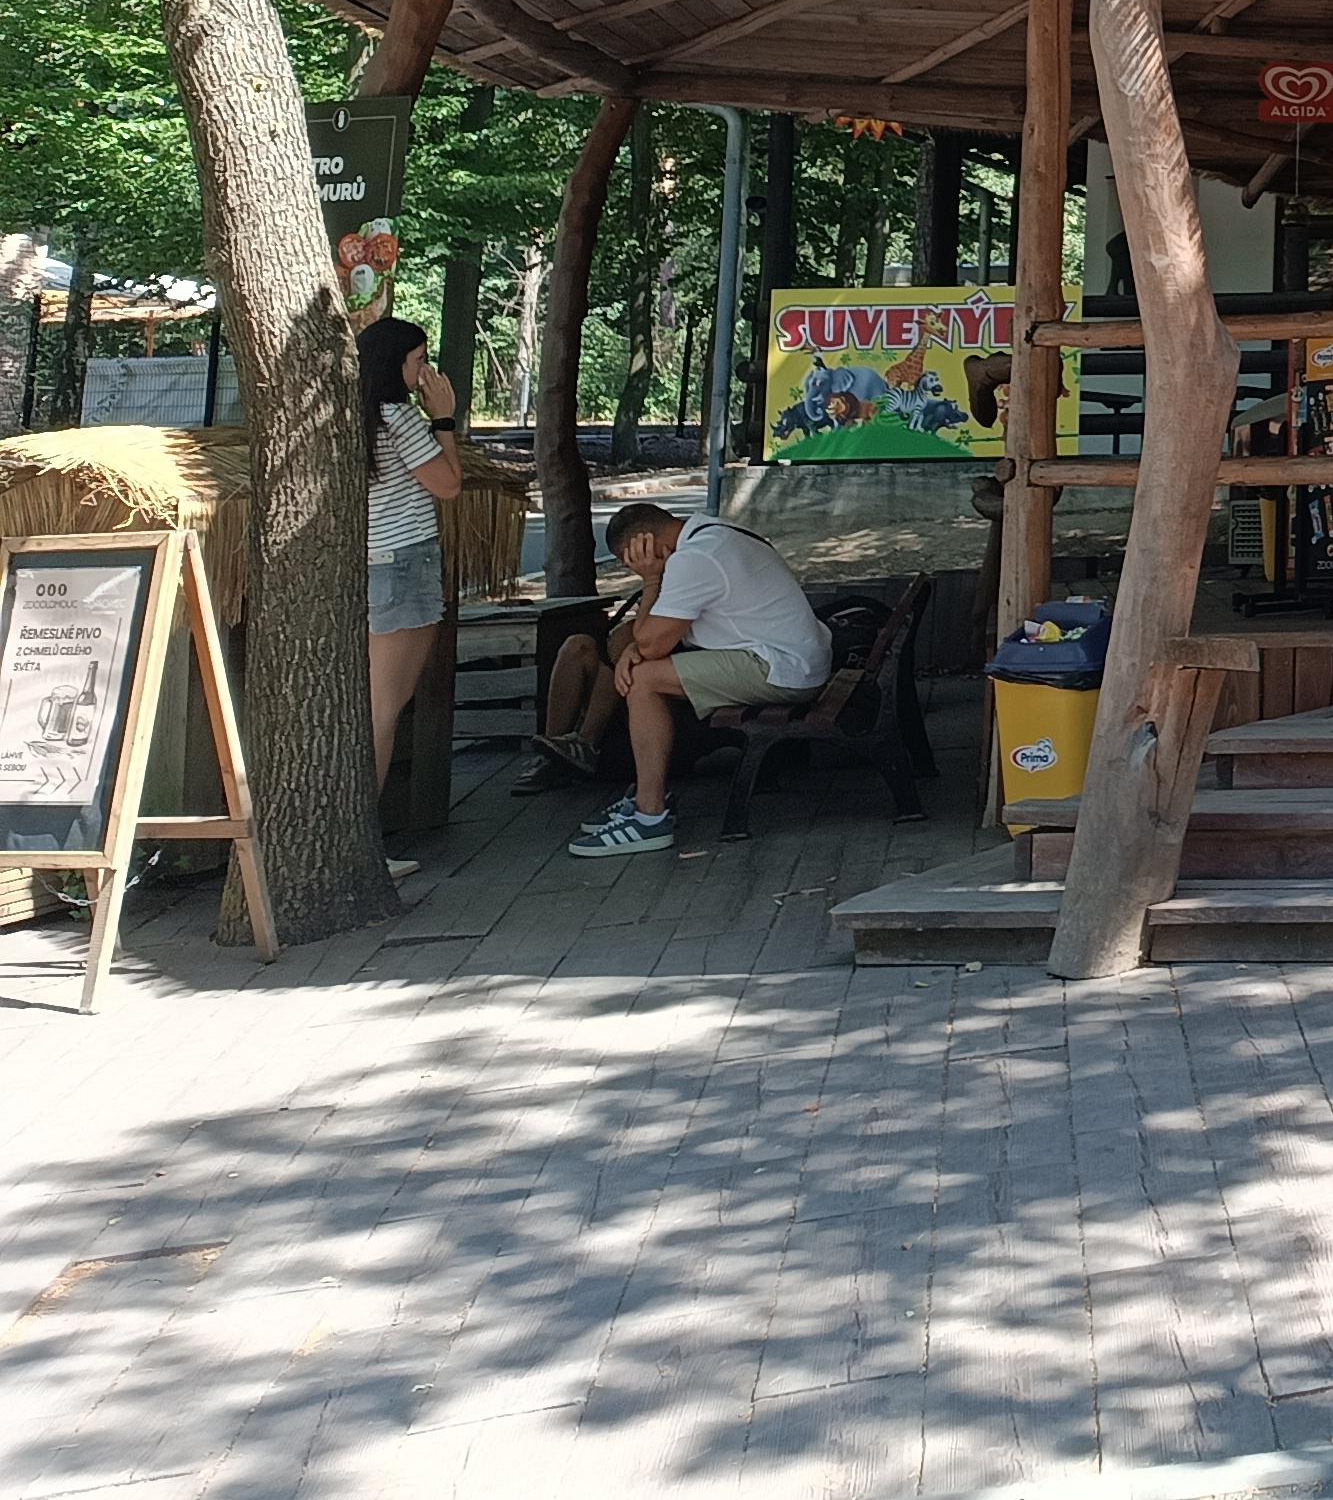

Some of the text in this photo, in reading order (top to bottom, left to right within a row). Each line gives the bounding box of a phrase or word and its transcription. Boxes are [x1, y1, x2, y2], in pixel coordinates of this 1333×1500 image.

[1270, 106, 1326, 117] ALGIDA
[313, 156, 344, 175] TRO
[318, 175, 365, 201] MURŮ
[23, 600, 78, 610] ZOOOLOMOUC
[20, 625, 102, 640] ŘEMESLNÉ PIVO
[16, 645, 92, 657] Z CHMELŮ CELÉHO
[13, 661, 41, 672] SVĚTA
[1020, 751, 1049, 763] Prima
